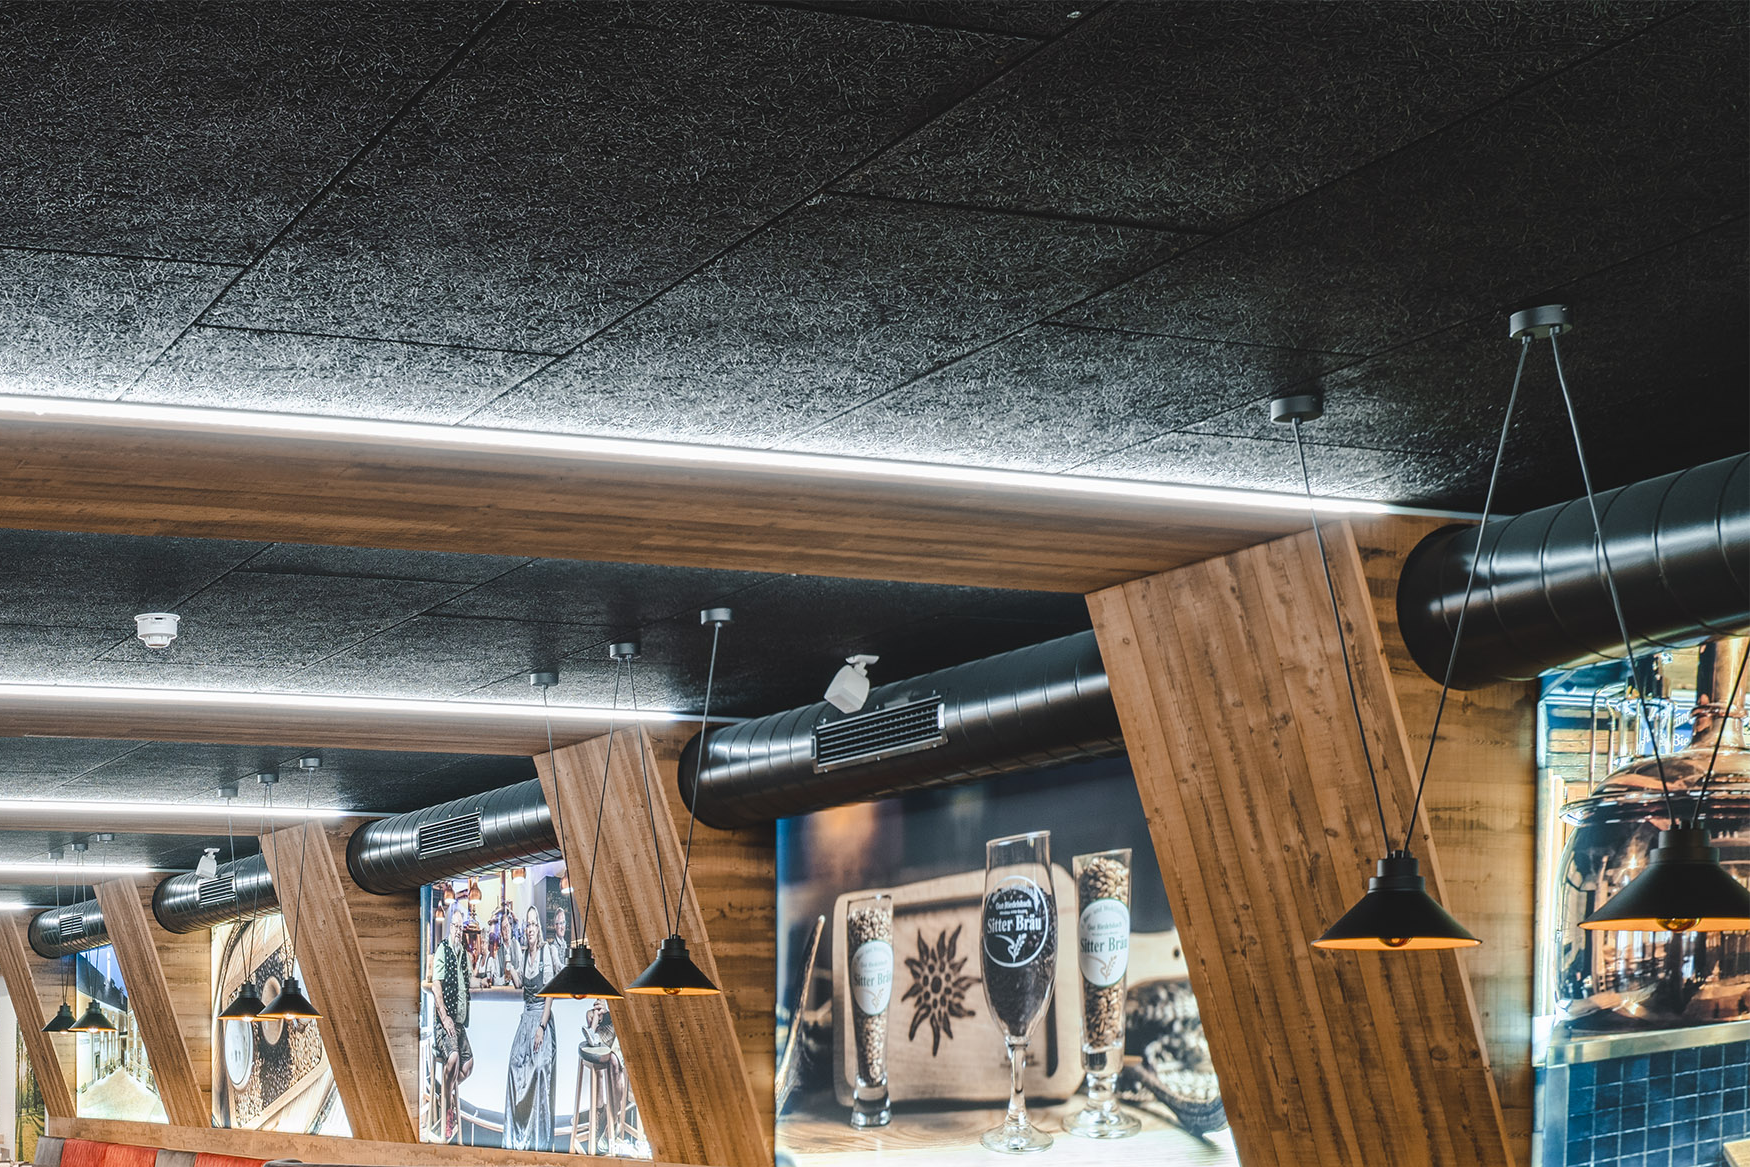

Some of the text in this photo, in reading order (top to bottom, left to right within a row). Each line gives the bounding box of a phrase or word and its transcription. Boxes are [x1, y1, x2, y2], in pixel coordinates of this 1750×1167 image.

[986, 914, 1042, 934] Sitter Bräu
[1080, 937, 1105, 953] Sitter
[853, 973, 875, 987] Sitter
